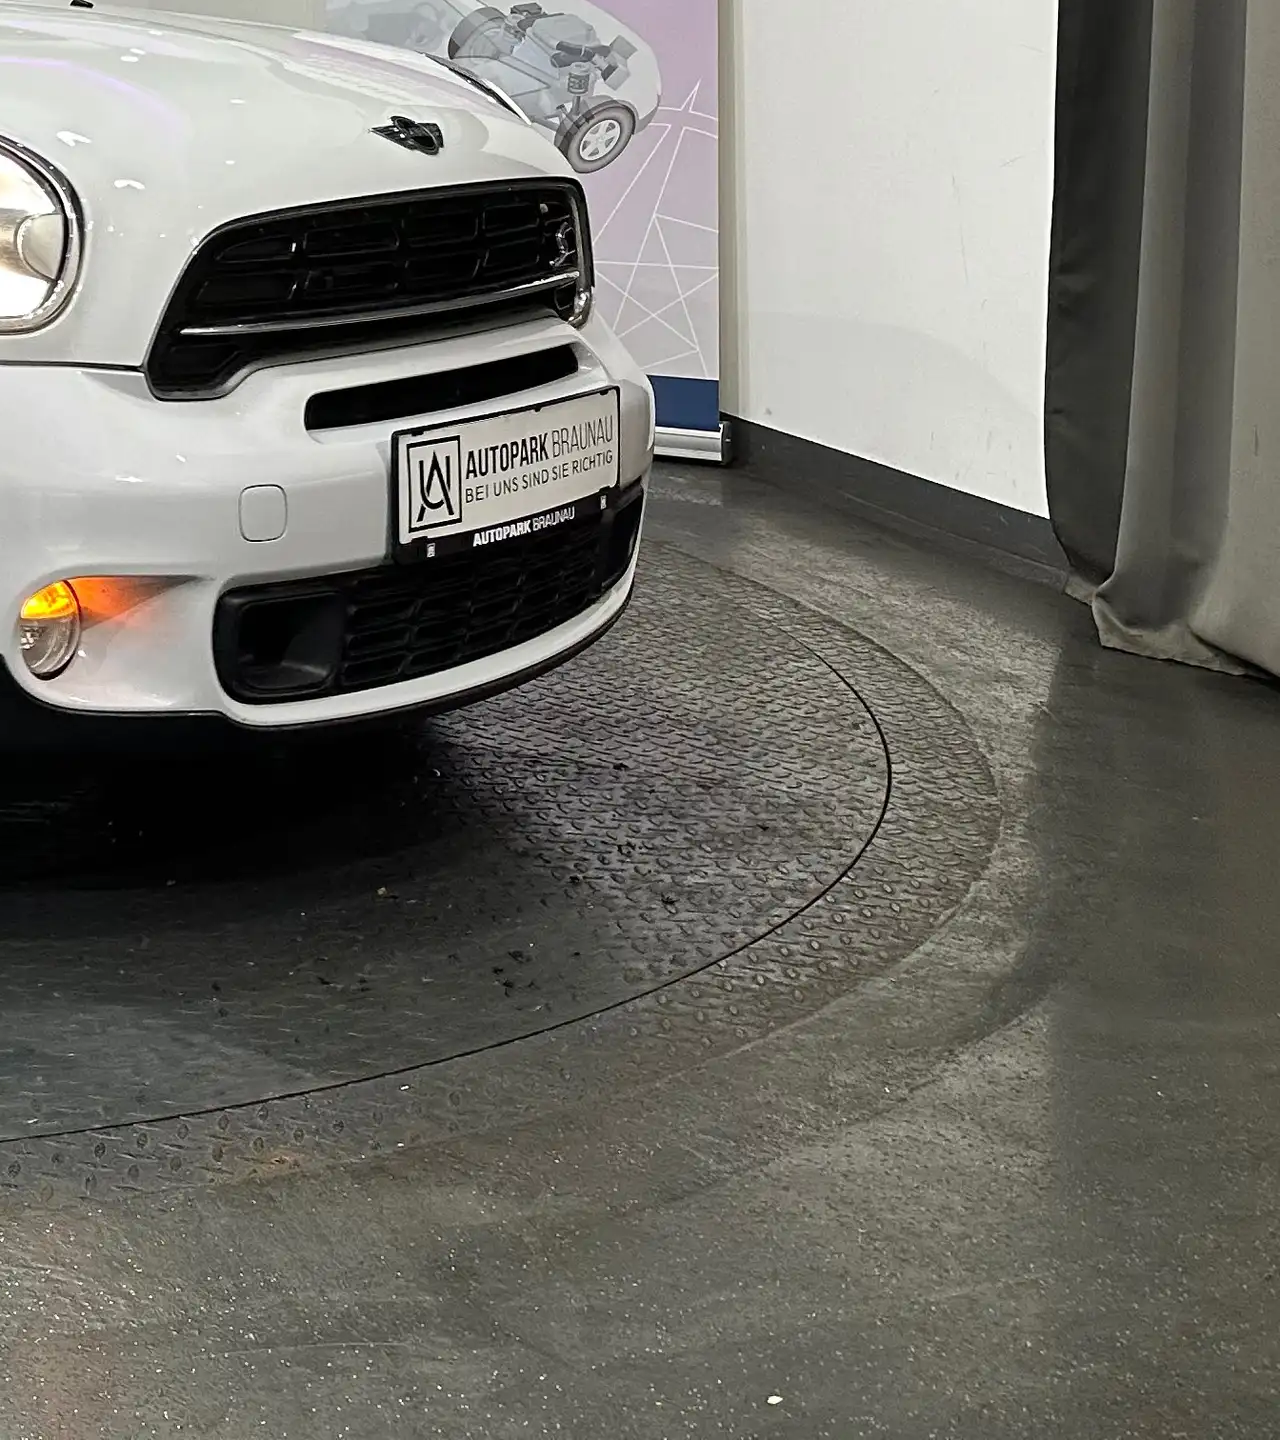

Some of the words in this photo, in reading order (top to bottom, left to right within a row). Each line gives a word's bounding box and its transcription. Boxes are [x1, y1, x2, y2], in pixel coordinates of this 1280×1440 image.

[466, 433, 549, 480] AUTOPARK
[552, 415, 613, 458] BRAUNAU
[465, 484, 489, 503] BEI
[494, 475, 519, 498] UNS
[523, 468, 549, 491] SIND
[552, 462, 569, 482] SIE
[572, 449, 613, 476] RICHTIG
[473, 520, 532, 547] AUTOPARK
[532, 506, 575, 531] BRAUNAU
